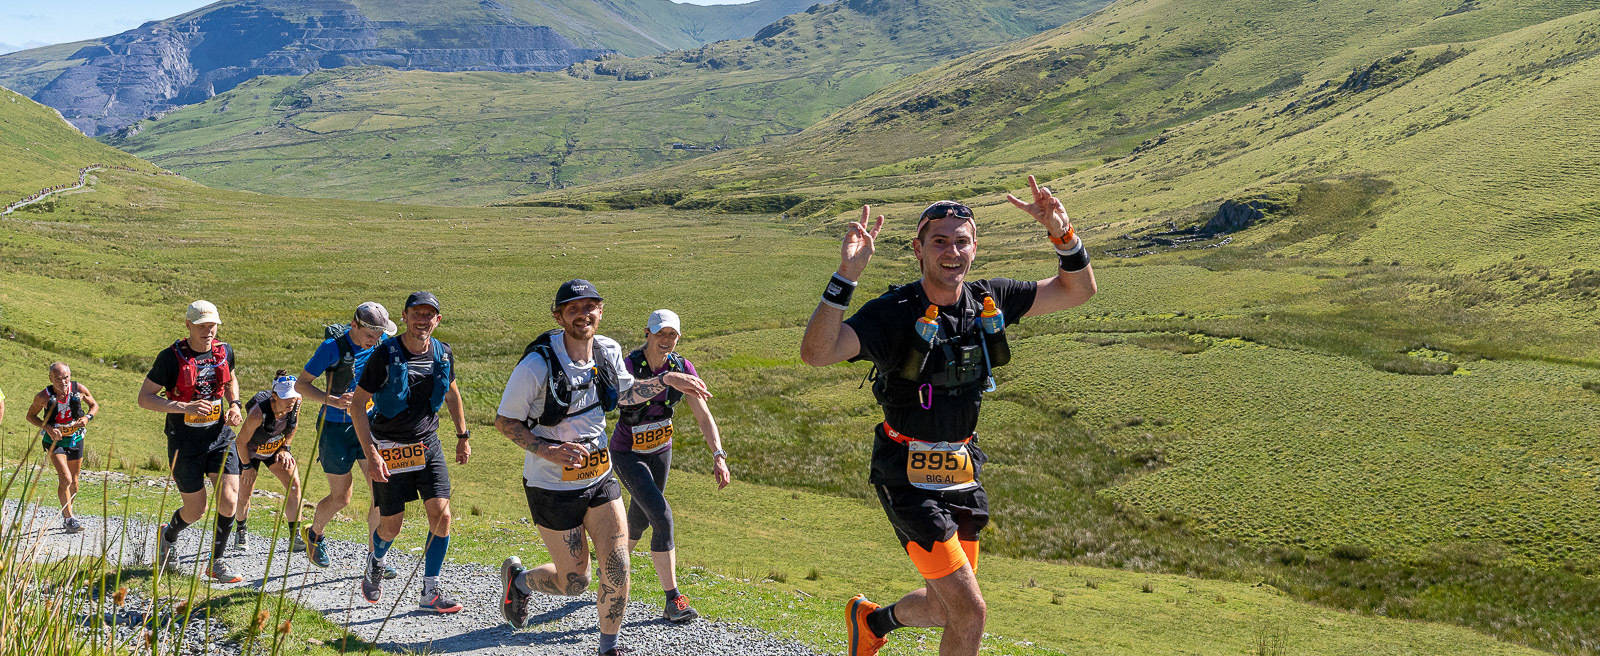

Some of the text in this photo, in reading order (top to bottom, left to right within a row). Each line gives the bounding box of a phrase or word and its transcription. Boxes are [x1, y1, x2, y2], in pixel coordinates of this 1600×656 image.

[635, 425, 673, 444] 8825
[382, 444, 423, 461] 8306
[911, 452, 968, 471] 8957
[576, 469, 599, 480] JONNY
[926, 474, 955, 483] BIG AL
